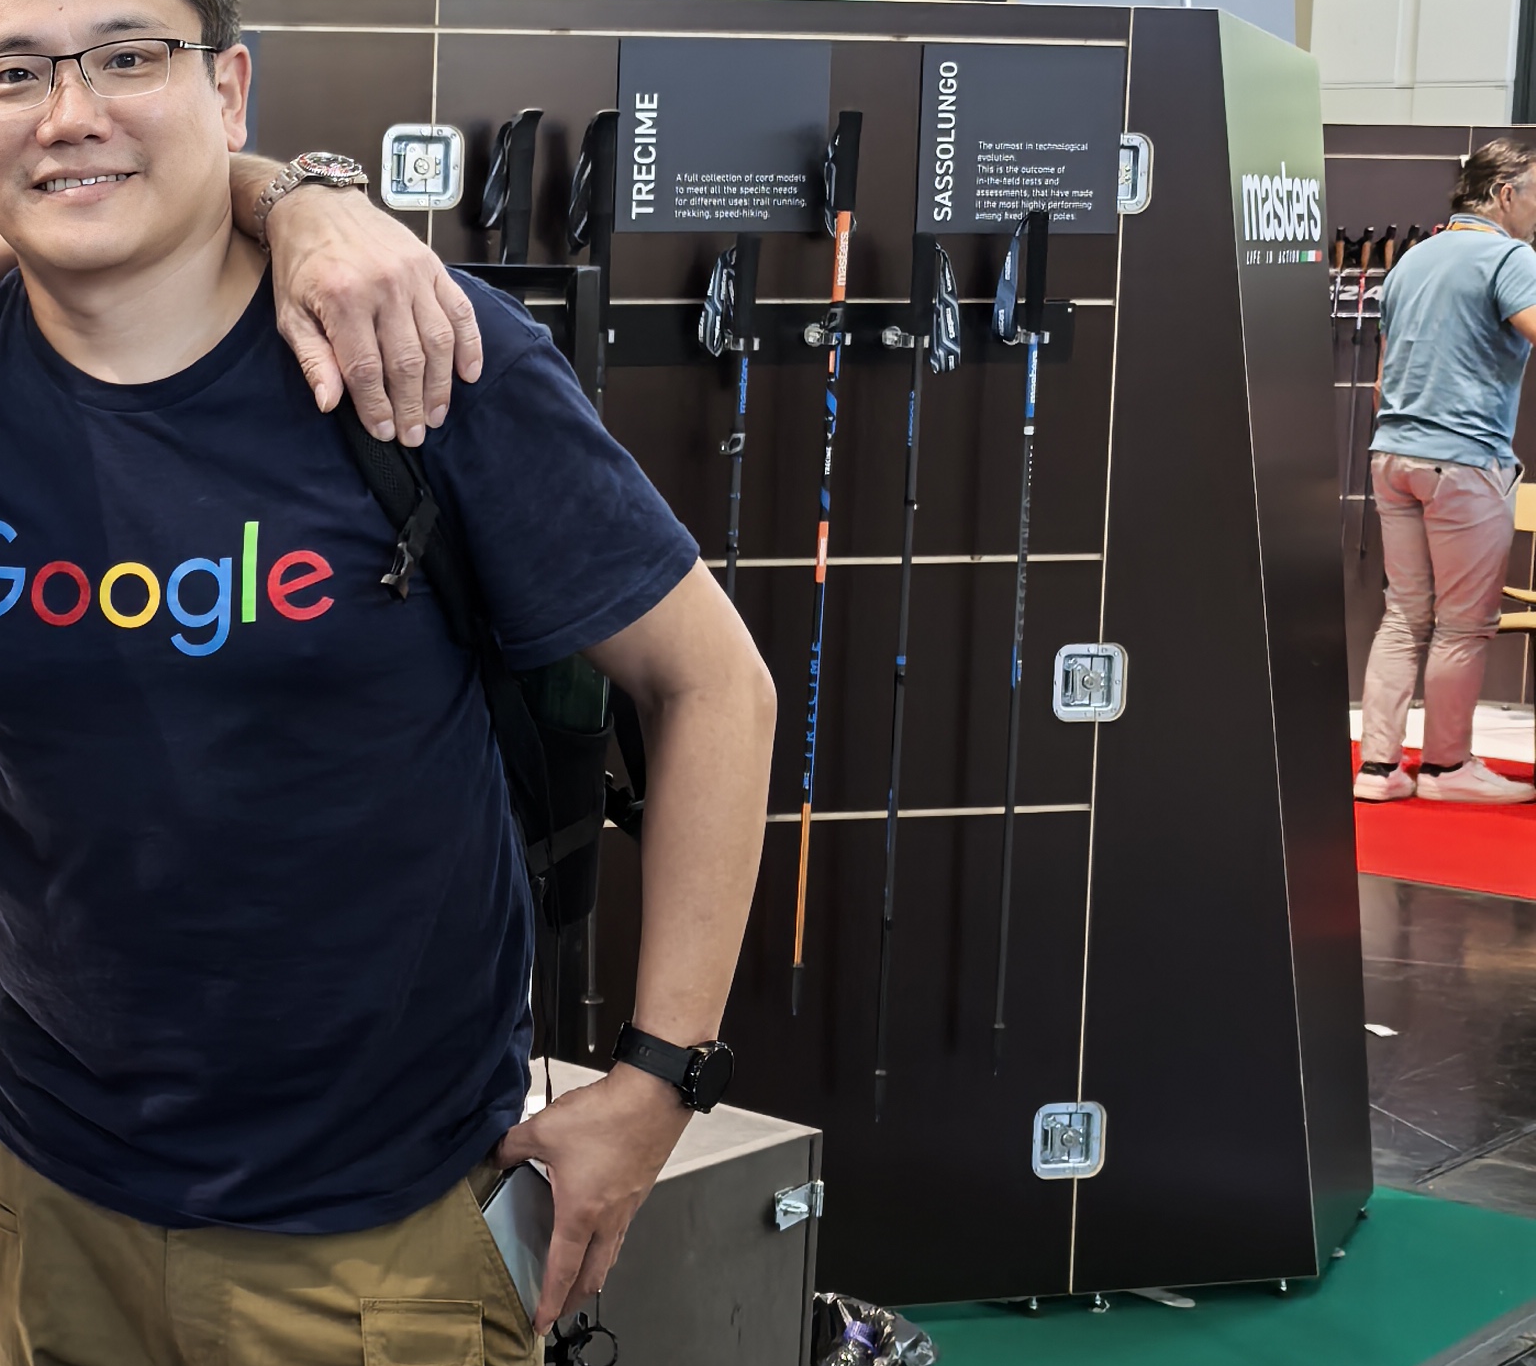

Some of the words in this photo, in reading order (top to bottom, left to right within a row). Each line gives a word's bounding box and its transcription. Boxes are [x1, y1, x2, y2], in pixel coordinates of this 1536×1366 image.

[934, 61, 958, 221] SASSOLUNGO
[978, 141, 992, 149] The
[995, 142, 1023, 150] utmost
[1036, 142, 1088, 151] technological
[631, 92, 658, 220] TRECIME
[978, 165, 993, 173] This
[996, 165, 1003, 173] is
[1006, 165, 1018, 173] the
[1021, 166, 1055, 174] outcome
[676, 173, 681, 181] A
[684, 173, 698, 182] full
[701, 174, 742, 182] collection
[745, 174, 753, 182] of
[777, 174, 806, 182] models
[1022, 177, 1042, 185] tests
[1044, 177, 1059, 185] and
[676, 186, 683, 194] to
[686, 186, 708, 194] meet
[710, 186, 720, 194] all
[723, 186, 736, 194] the
[773, 186, 797, 194] needs
[1032, 189, 1048, 197] that
[1051, 189, 1069, 197] have
[1072, 189, 1093, 197] made
[675, 197, 688, 205] for
[690, 197, 725, 206] different
[753, 197, 770, 205] trail
[976, 200, 980, 209] it
[984, 200, 996, 209] the
[999, 201, 1018, 209] most
[1048, 201, 1092, 211] performing
[1242, 161, 1322, 242] masters
[836, 232, 849, 286] masters
